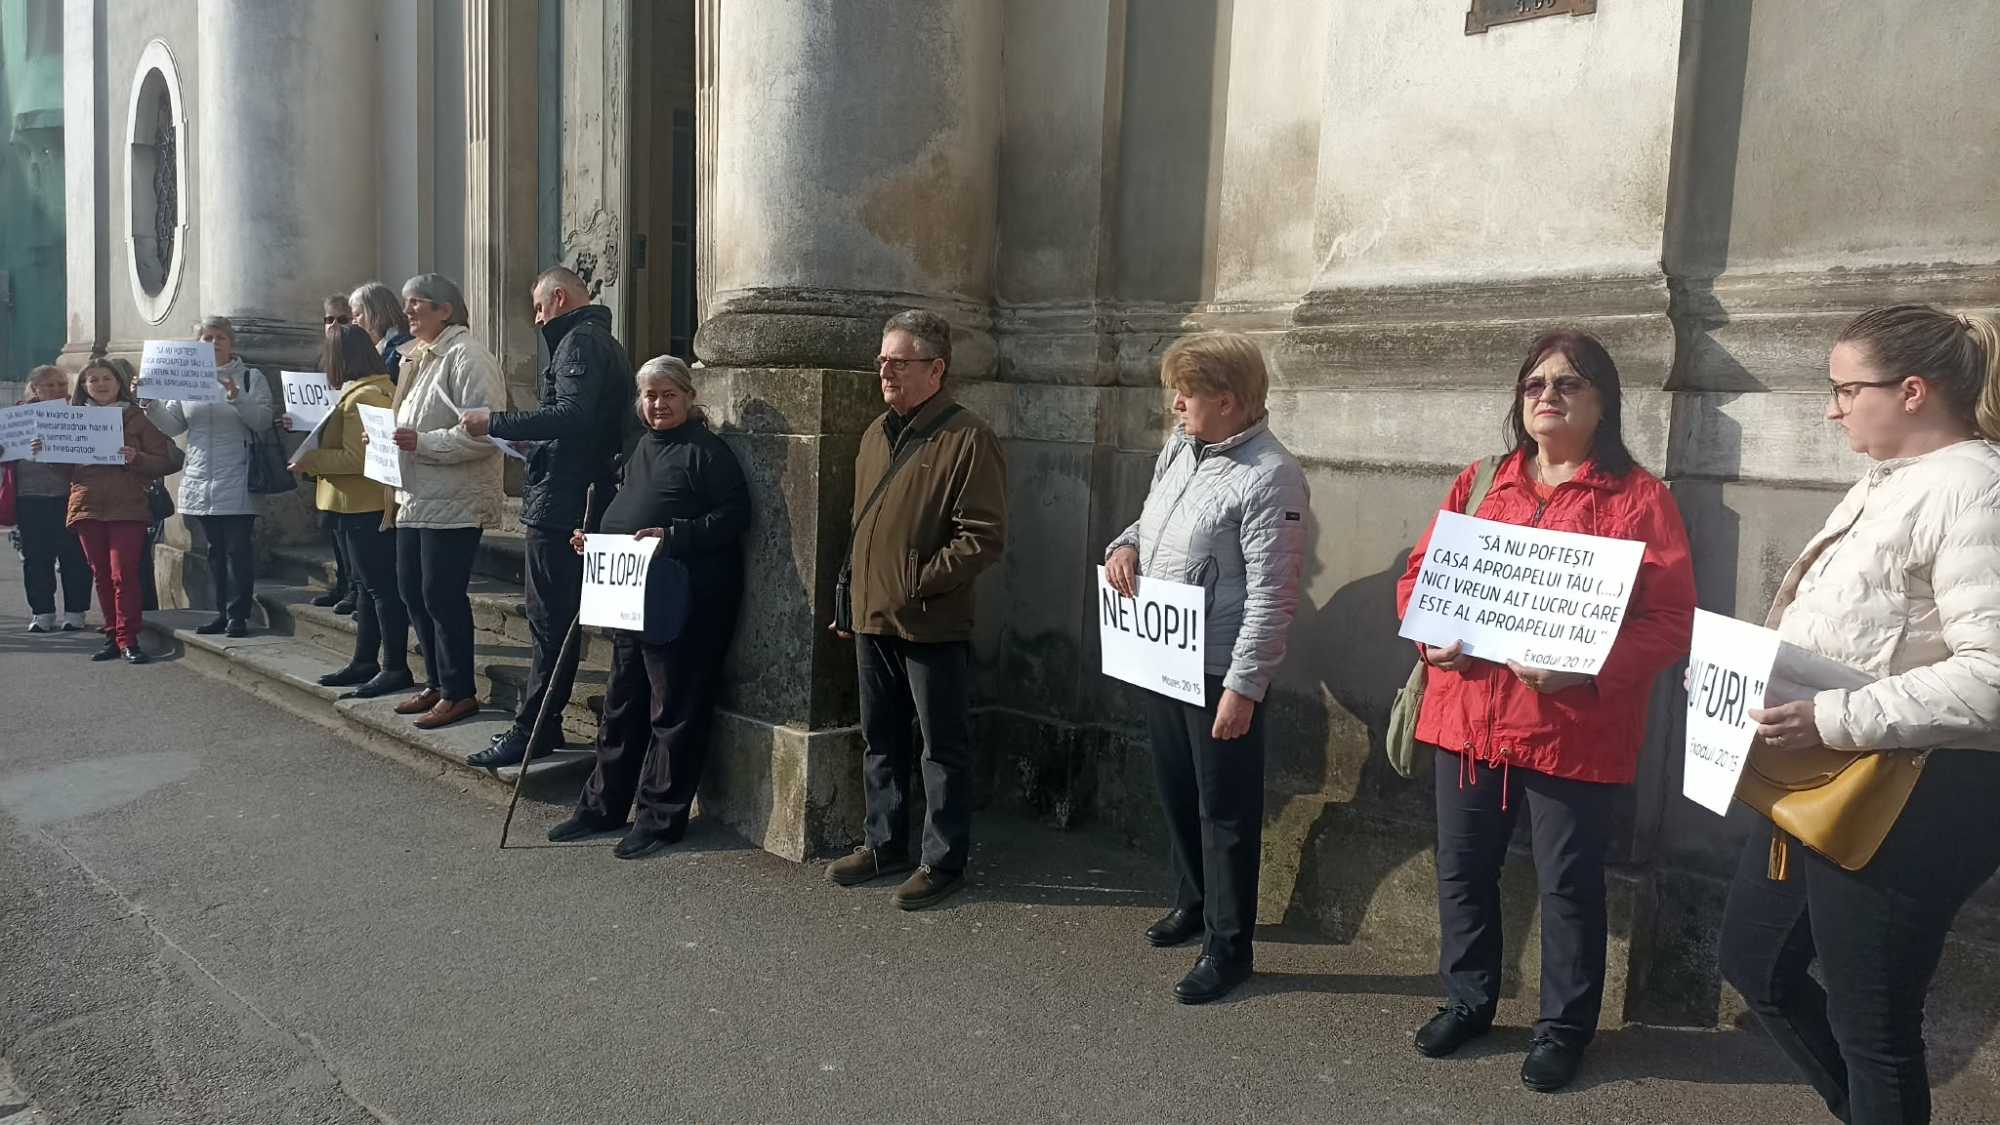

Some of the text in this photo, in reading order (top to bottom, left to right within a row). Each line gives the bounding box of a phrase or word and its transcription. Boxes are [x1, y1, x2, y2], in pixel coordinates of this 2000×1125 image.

[586, 551, 646, 587] NE LOPJ!
[1433, 548, 1468, 570] CASA
[1473, 558, 1562, 588] APROAPELUI
[1566, 572, 1593, 593] TĂU
[1505, 539, 1526, 556] NU
[1528, 543, 1595, 568] POFTEȘTI
[1418, 593, 1452, 615] ESTE
[1454, 603, 1470, 621] AL
[1475, 608, 1565, 638] APROAPELUI
[1421, 569, 1621, 623] NICI VREUN ALT LUCRU CARE
[1103, 587, 1197, 652] NE LOPJ!
[1524, 649, 1561, 666] Exodul
